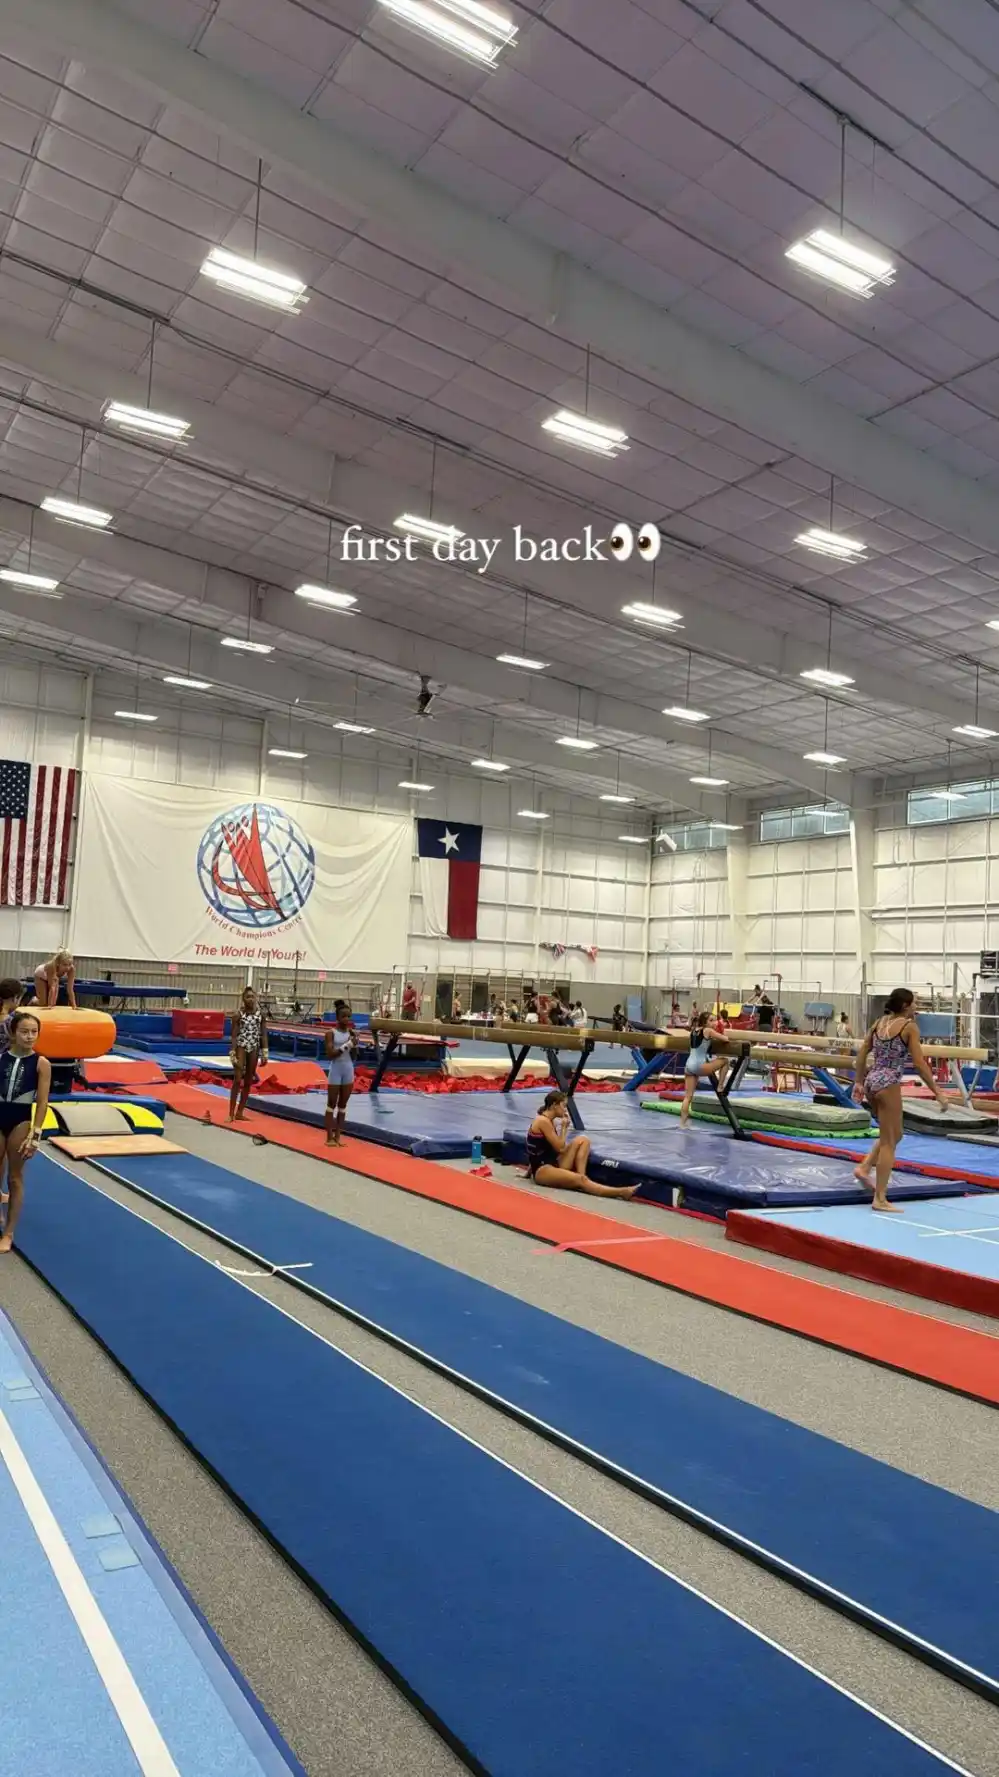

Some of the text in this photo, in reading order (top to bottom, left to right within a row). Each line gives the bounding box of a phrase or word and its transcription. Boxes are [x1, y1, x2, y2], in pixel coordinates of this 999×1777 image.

[205, 906, 228, 930] World
[229, 925, 277, 940] Champions
[195, 944, 307, 960] The World Is Yours!
